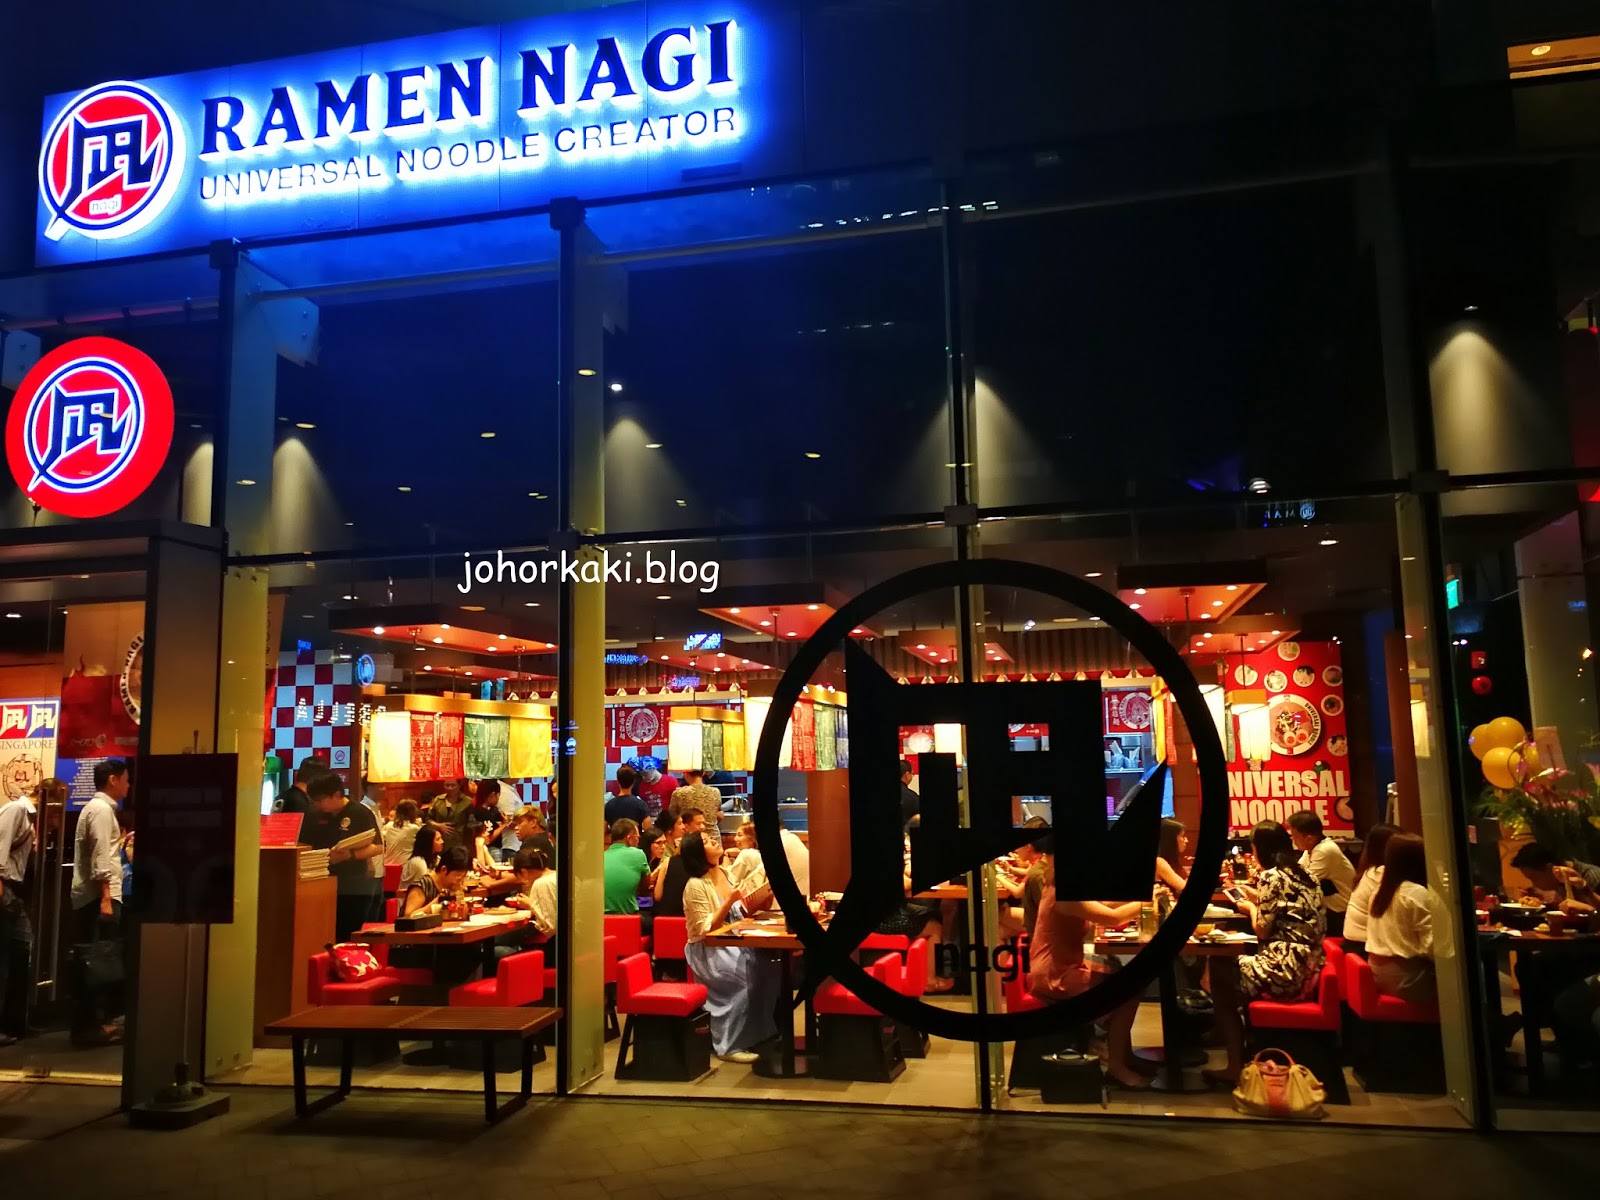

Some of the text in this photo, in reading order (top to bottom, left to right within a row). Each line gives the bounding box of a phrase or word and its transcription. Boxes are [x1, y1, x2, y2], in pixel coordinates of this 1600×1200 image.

[201, 20, 736, 154] RAMEN NAGI
[200, 106, 736, 200] UNIVERSAL NOODLE CREATOR
[89, 198, 121, 214] nagi
[1227, 770, 1350, 797] NIVERSAL
